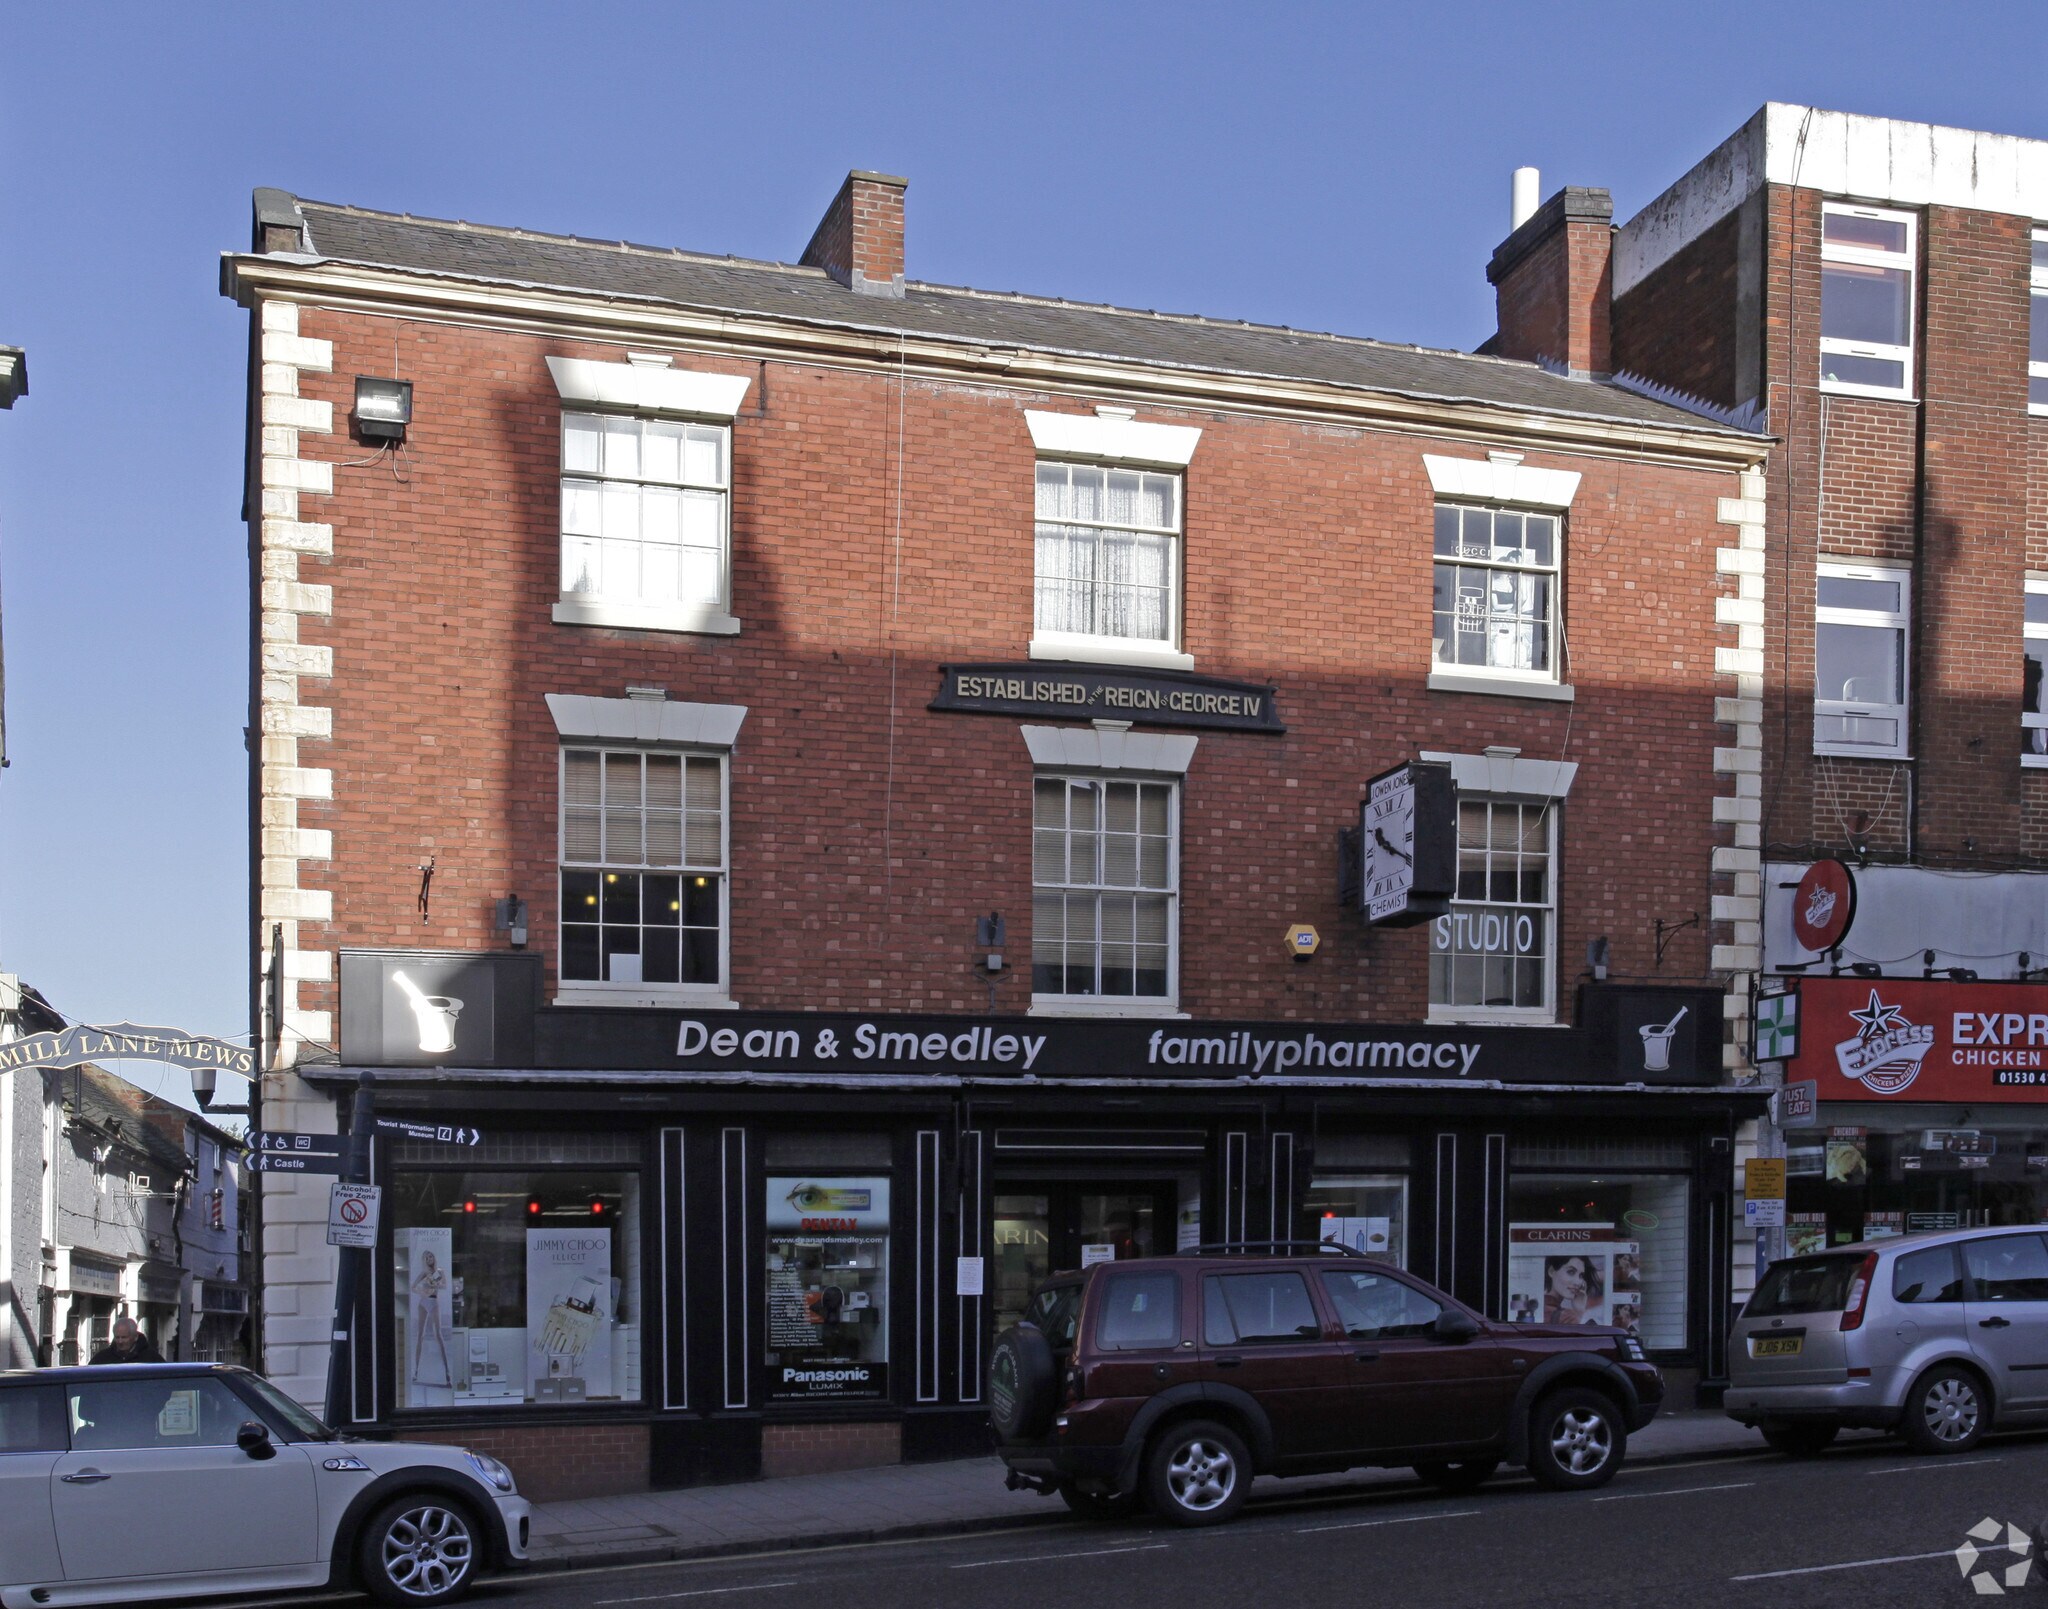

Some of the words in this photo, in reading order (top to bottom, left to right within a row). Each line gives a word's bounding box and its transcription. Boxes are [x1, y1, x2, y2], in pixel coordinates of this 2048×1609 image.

[957, 676, 1086, 705] ESTABLISHED
[1093, 684, 1104, 699] THE
[1105, 687, 1160, 710] REIGN
[1160, 694, 1169, 707] OF
[1169, 691, 1241, 716] GEORGE
[1243, 697, 1261, 717] IV
[1370, 892, 1408, 917] CHEMIST
[1436, 912, 1533, 952] STUDIO
[1297, 933, 1313, 945] ADT
[1952, 1012, 2048, 1046] EXPR
[676, 1020, 800, 1058] Dean
[813, 1028, 840, 1059] &
[852, 1023, 1047, 1069] Smedley
[0, 1039, 70, 1070] MILL
[80, 1034, 160, 1053] LANE
[169, 1038, 253, 1072] MEWS
[1148, 1030, 1481, 1075] familypharmacy
[1952, 1050, 2041, 1066] CHICKEN
[1867, 1073, 1894, 1087] CHICKEN
[1895, 1078, 1901, 1086] &
[1900, 1063, 1915, 1082] PIZZA
[1999, 1072, 2035, 1084] 01530
[2039, 1073, 2048, 1084] 4
[1783, 1087, 1805, 1103] JUST
[1788, 1101, 1805, 1115] EAT
[377, 1119, 398, 1129] Tourist
[399, 1122, 435, 1132] Information
[408, 1130, 435, 1139] Museum
[298, 1138, 309, 1148] WC
[274, 1158, 306, 1169] Castle
[341, 1185, 372, 1193] Alcohol
[802, 1218, 857, 1231] PENTAX
[1528, 1231, 1591, 1240] CLARINS
[533, 1240, 567, 1251] JIMMY
[567, 1239, 606, 1250] CHOO
[552, 1253, 587, 1261] ILLICIT
[783, 1366, 870, 1382] Panasonic
[809, 1382, 844, 1390] LUMIX
